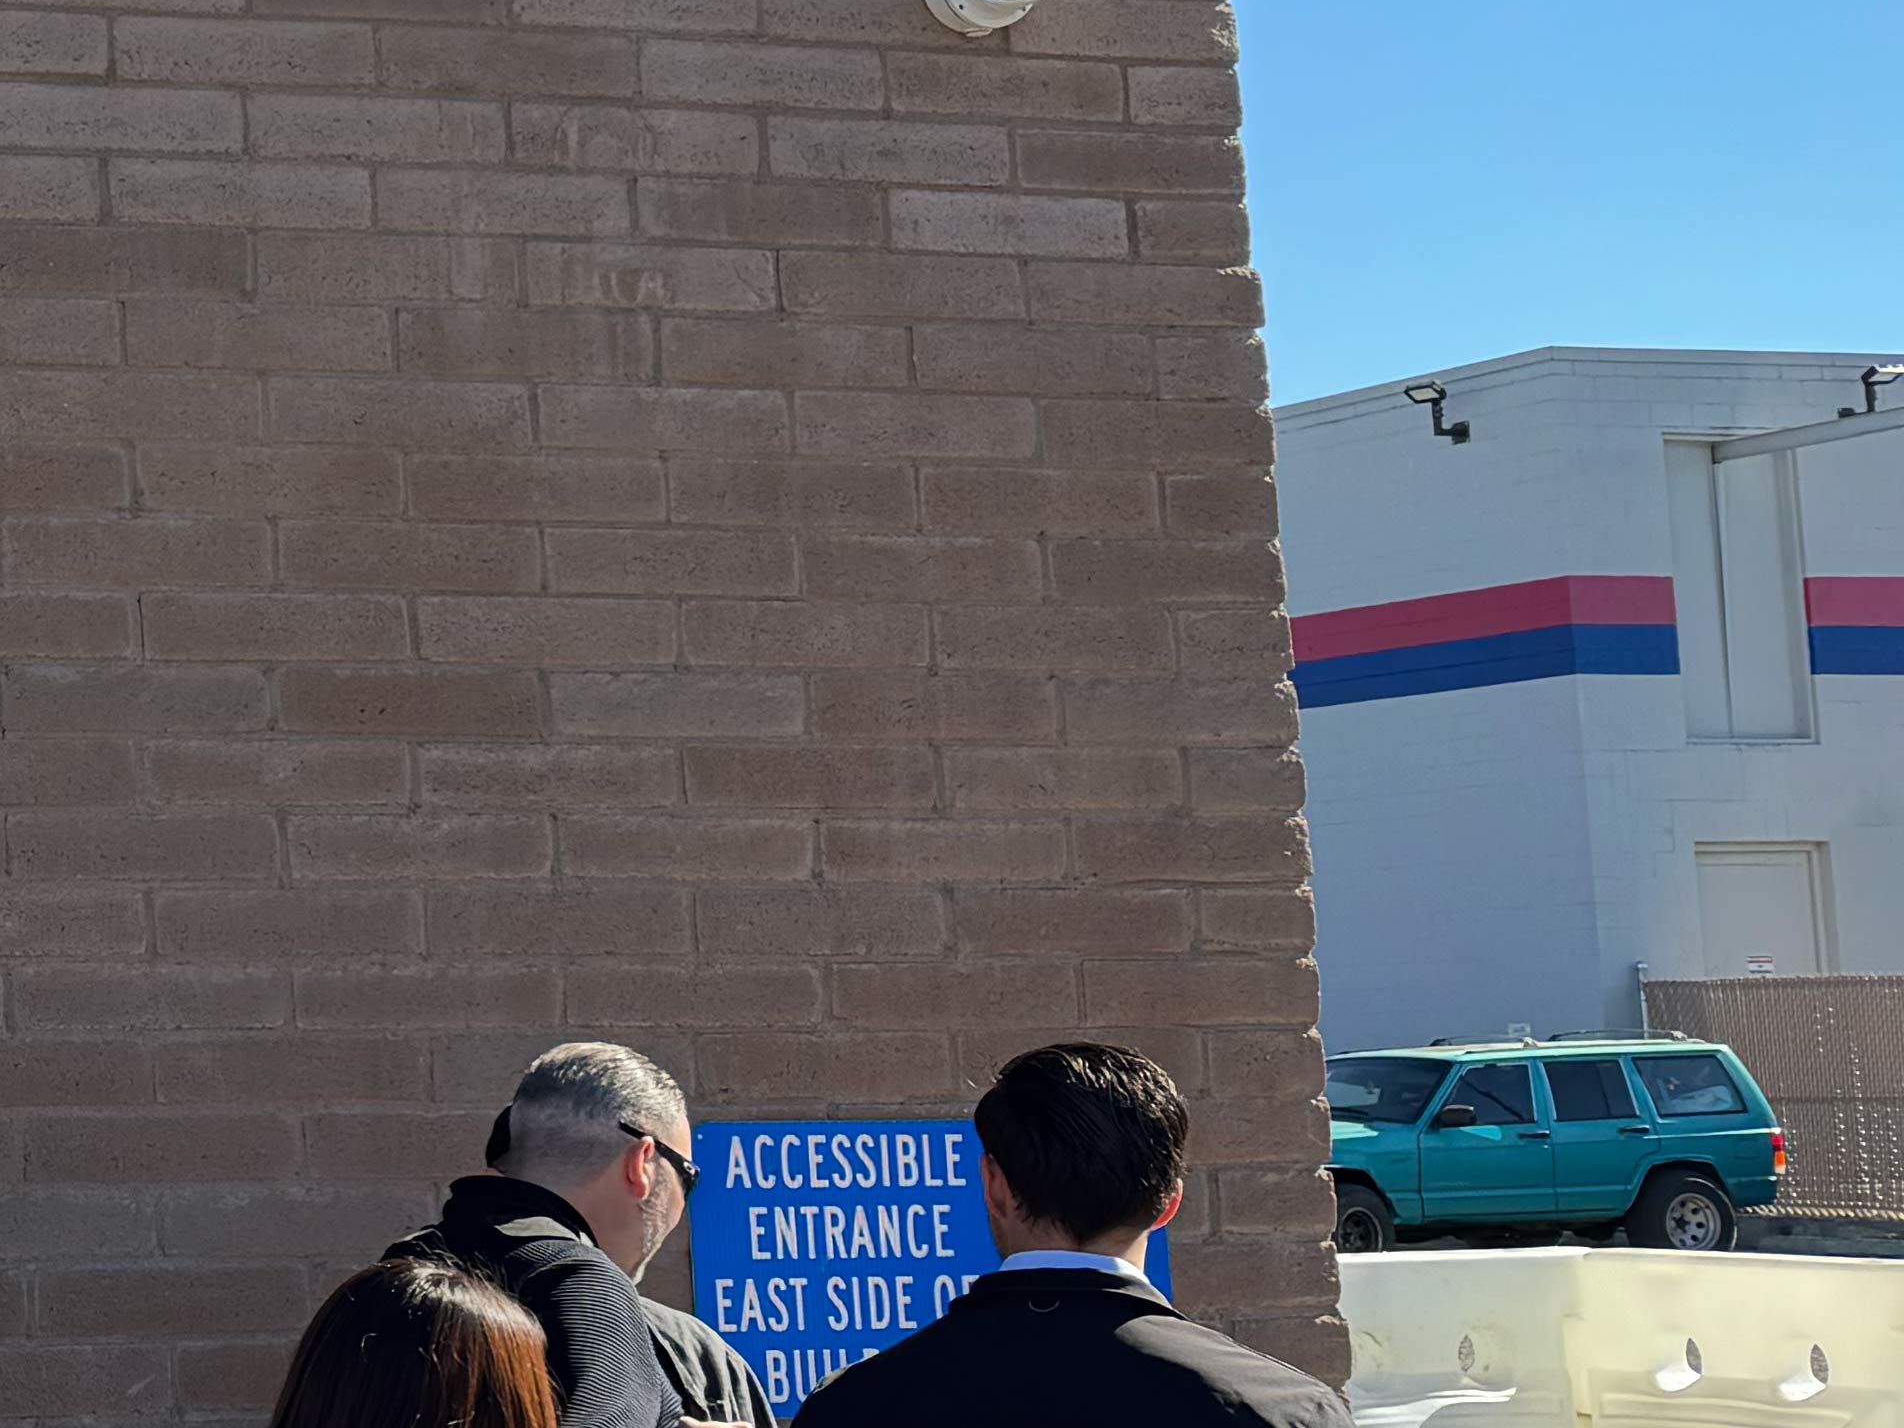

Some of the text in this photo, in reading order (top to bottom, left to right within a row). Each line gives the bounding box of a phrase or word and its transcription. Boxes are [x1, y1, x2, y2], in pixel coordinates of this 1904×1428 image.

[725, 1133, 967, 1189] ACCESSIBLE
[748, 1203, 955, 1262] ENTRANCE
[715, 1277, 808, 1333] EAST
[827, 1275, 918, 1332] SIDE
